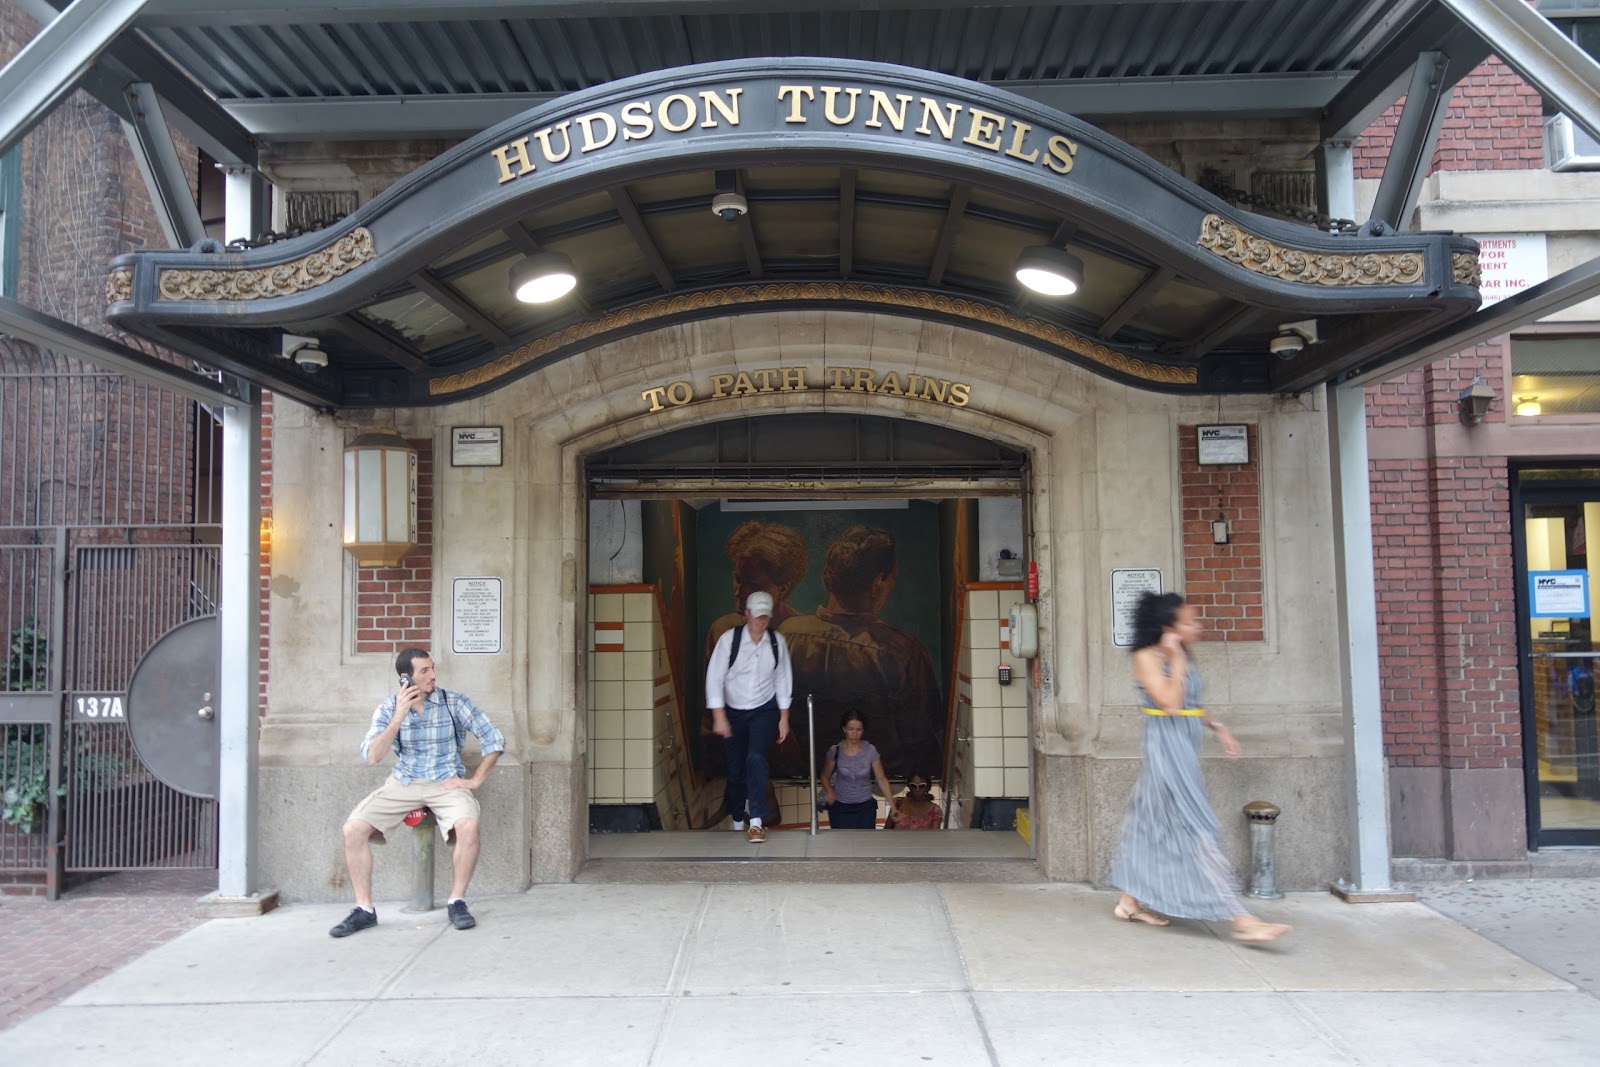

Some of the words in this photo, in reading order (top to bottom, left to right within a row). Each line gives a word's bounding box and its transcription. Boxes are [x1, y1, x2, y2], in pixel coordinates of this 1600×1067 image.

[491, 88, 743, 183] HUDSON
[778, 86, 1078, 174] TUNNELS
[1479, 240, 1516, 249] ARTMENTS
[1479, 262, 1508, 270] RENT
[1505, 279, 1530, 287] INC.
[641, 381, 693, 412] TO
[709, 367, 808, 398] PATH
[827, 366, 972, 406] TRAINS
[77, 697, 123, 717] 137A
